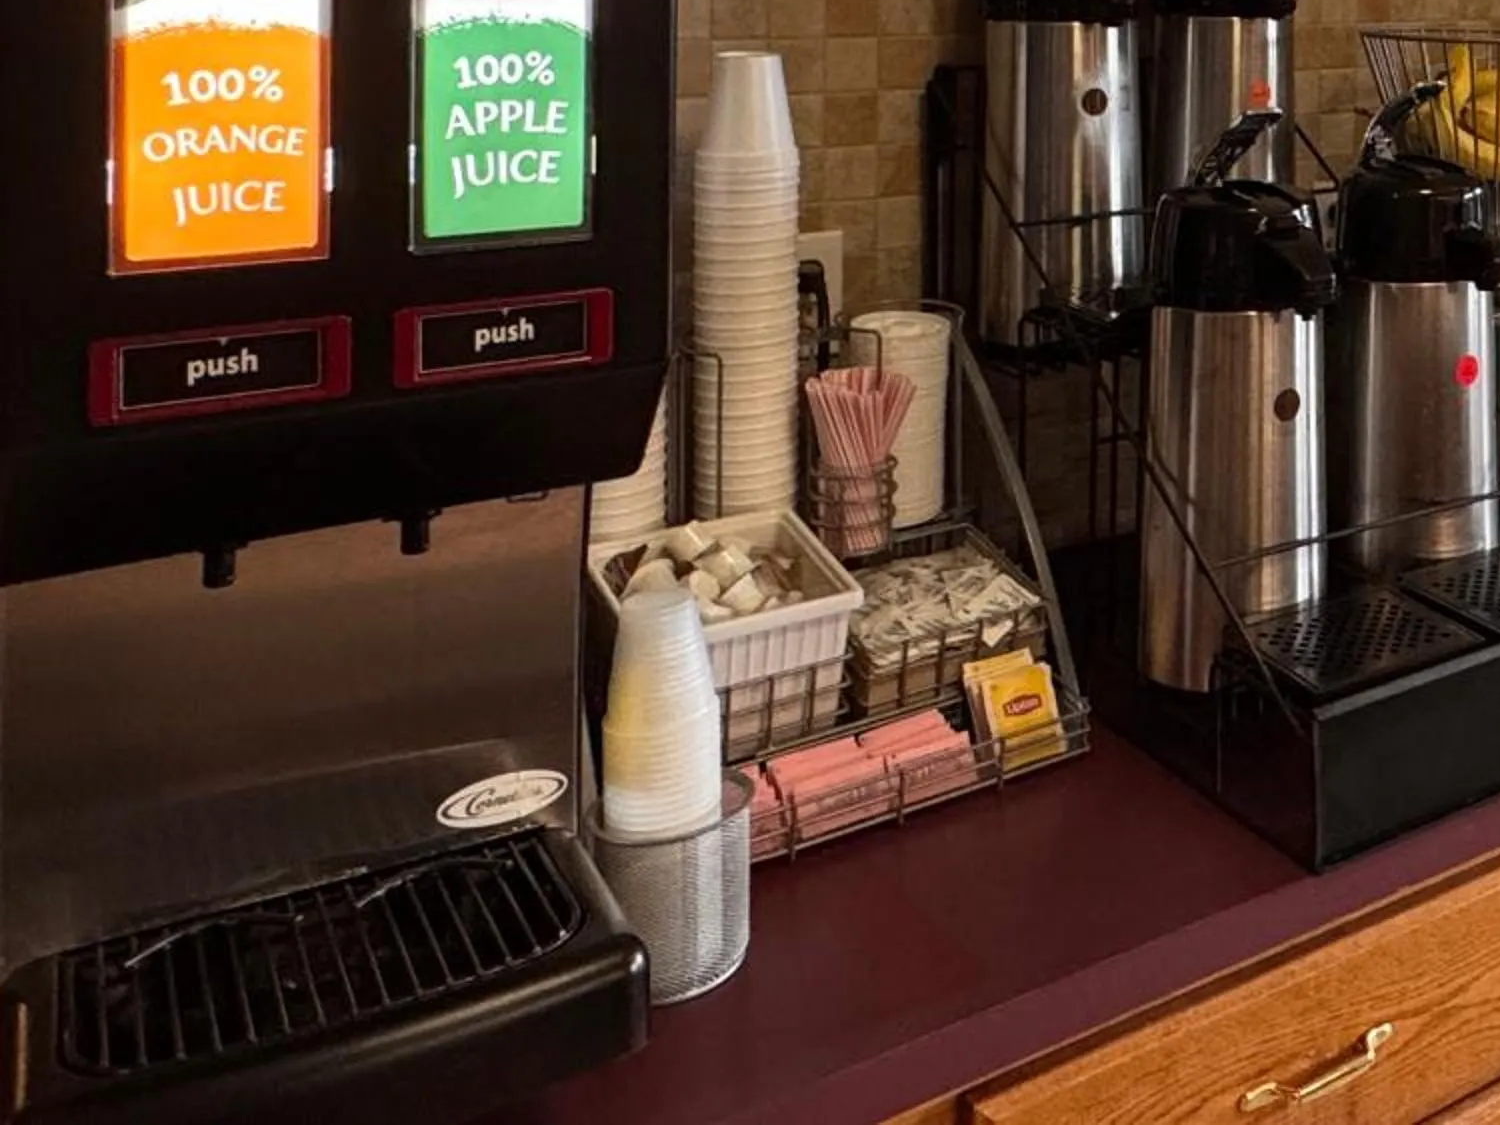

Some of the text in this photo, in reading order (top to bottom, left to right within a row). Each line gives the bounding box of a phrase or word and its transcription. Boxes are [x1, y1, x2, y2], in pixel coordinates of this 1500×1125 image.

[160, 64, 284, 107] 100%
[452, 50, 555, 89] 100%
[445, 98, 569, 140] APPLE
[142, 124, 308, 163] ORANGE
[451, 149, 563, 200] JUICE
[172, 180, 287, 227] JUICE
[475, 317, 535, 352] push
[186, 348, 259, 387] push
